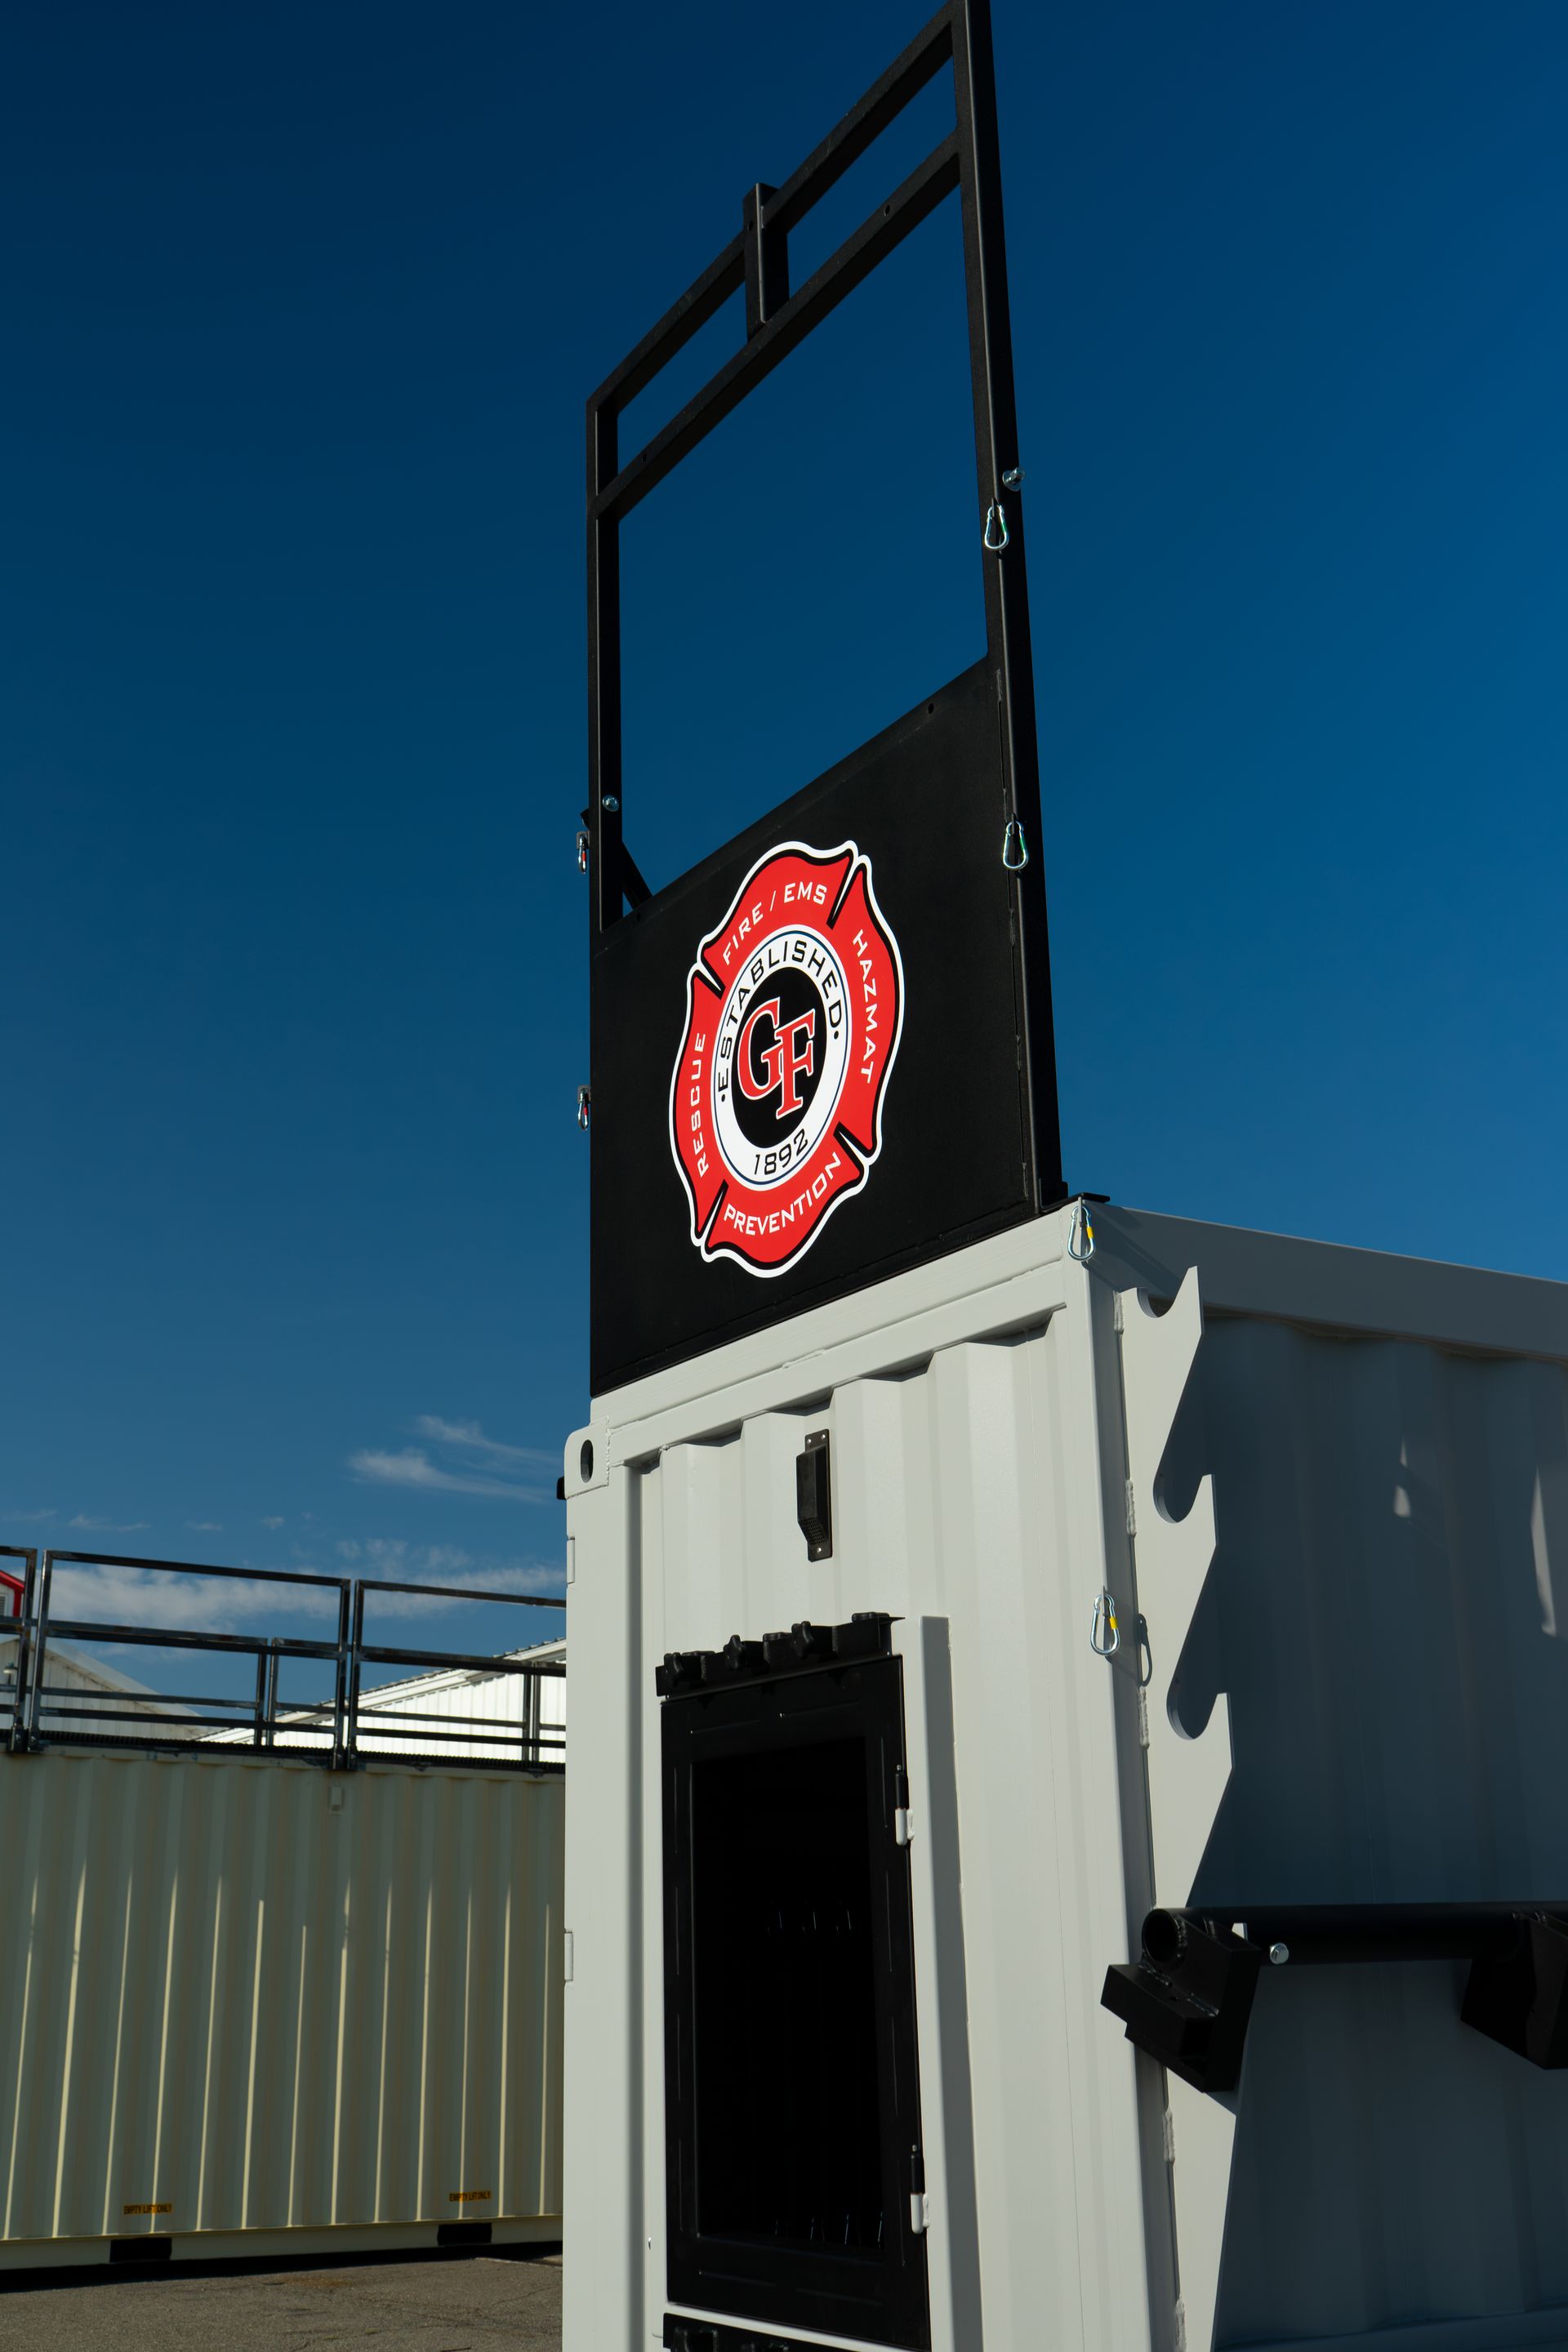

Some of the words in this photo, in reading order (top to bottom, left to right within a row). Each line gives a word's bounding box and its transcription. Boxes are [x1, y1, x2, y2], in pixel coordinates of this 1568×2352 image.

[722, 902, 764, 966] FIRE
[783, 881, 828, 906] EMS
[717, 940, 843, 1096] ESTABLISHED
[737, 996, 817, 1120] GF
[852, 929, 880, 1084] HAZMAT
[690, 1032, 710, 1178] RESCUE
[754, 1129, 808, 1176] 1892
[723, 1152, 841, 1237] PREVENTION
